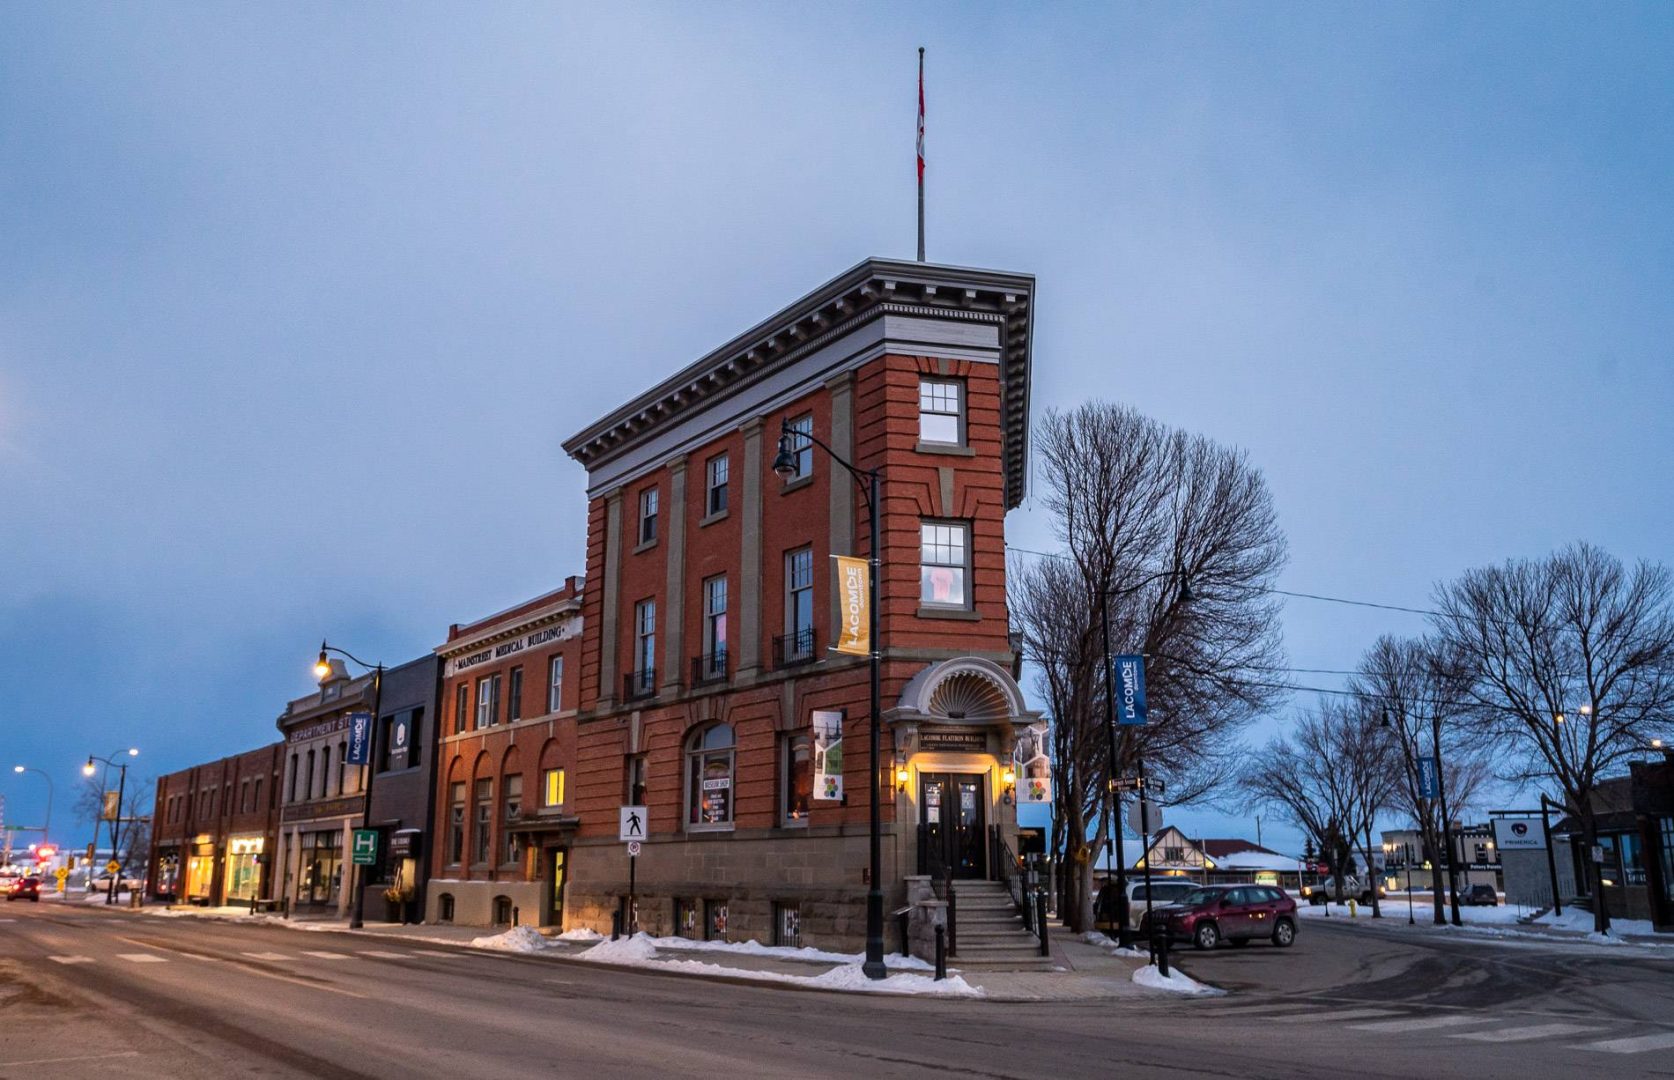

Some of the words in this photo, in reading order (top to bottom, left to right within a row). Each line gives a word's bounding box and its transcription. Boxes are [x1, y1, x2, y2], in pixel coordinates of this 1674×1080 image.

[457, 650, 492, 669] MAINSTREET
[495, 639, 524, 658] MEDICAL
[527, 626, 562, 647] BUILDING
[290, 720, 337, 743] DEPARTMENT
[356, 834, 374, 851] H
